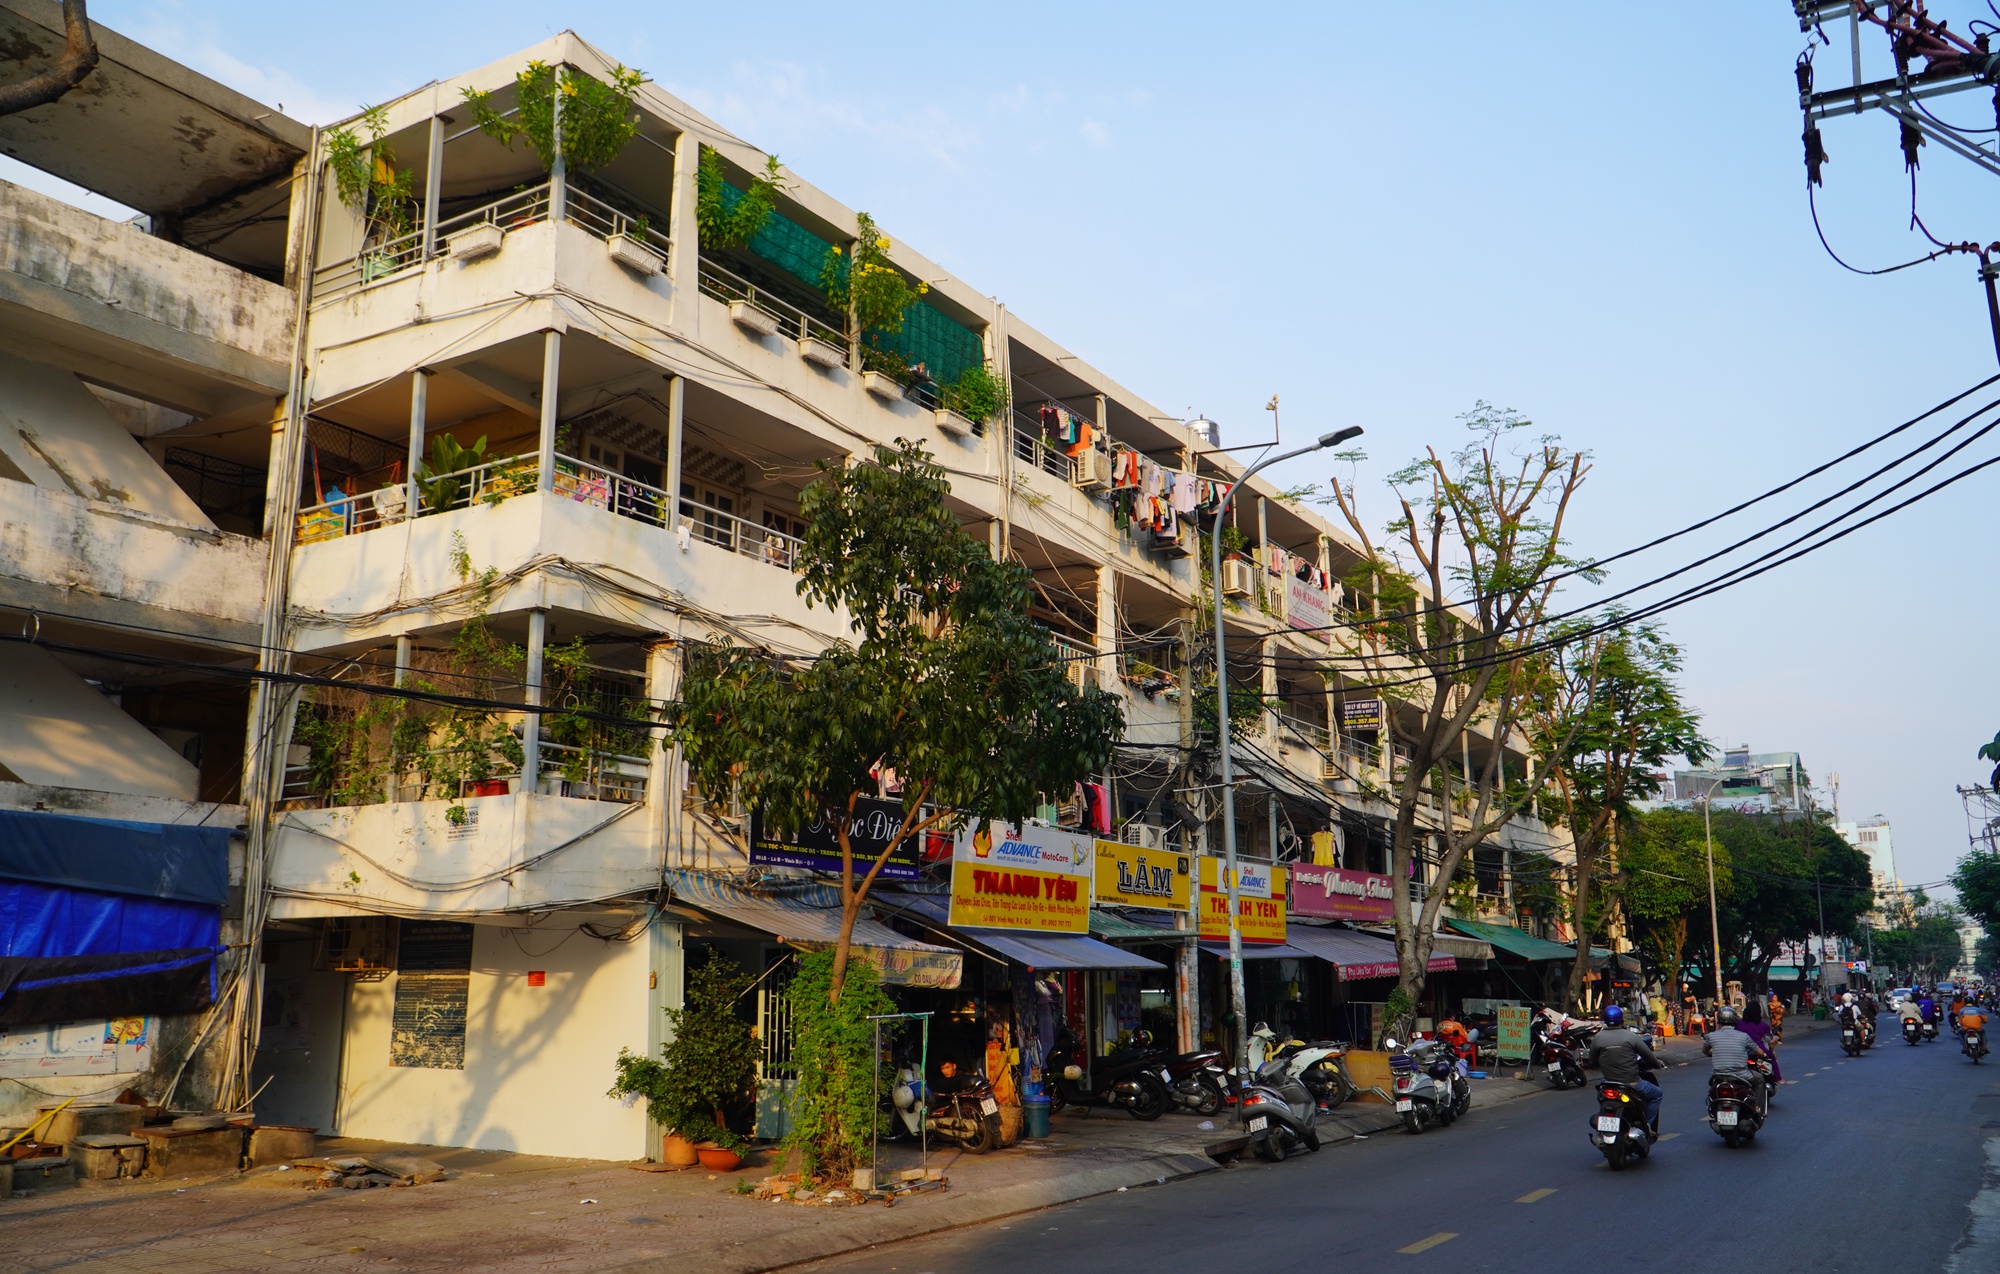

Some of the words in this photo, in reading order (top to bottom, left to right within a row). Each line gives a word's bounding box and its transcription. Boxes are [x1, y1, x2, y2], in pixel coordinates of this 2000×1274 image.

[1006, 830, 1022, 842] Shell
[997, 842, 1042, 858] ADVANCE
[1042, 851, 1069, 862] MotoCare
[1244, 866, 1254, 875] Shell
[972, 870, 1040, 898] THANH
[1240, 876, 1266, 888] ADVANCE
[1211, 897, 1252, 916] THNH
[1519, 1011, 1528, 1019] XE
